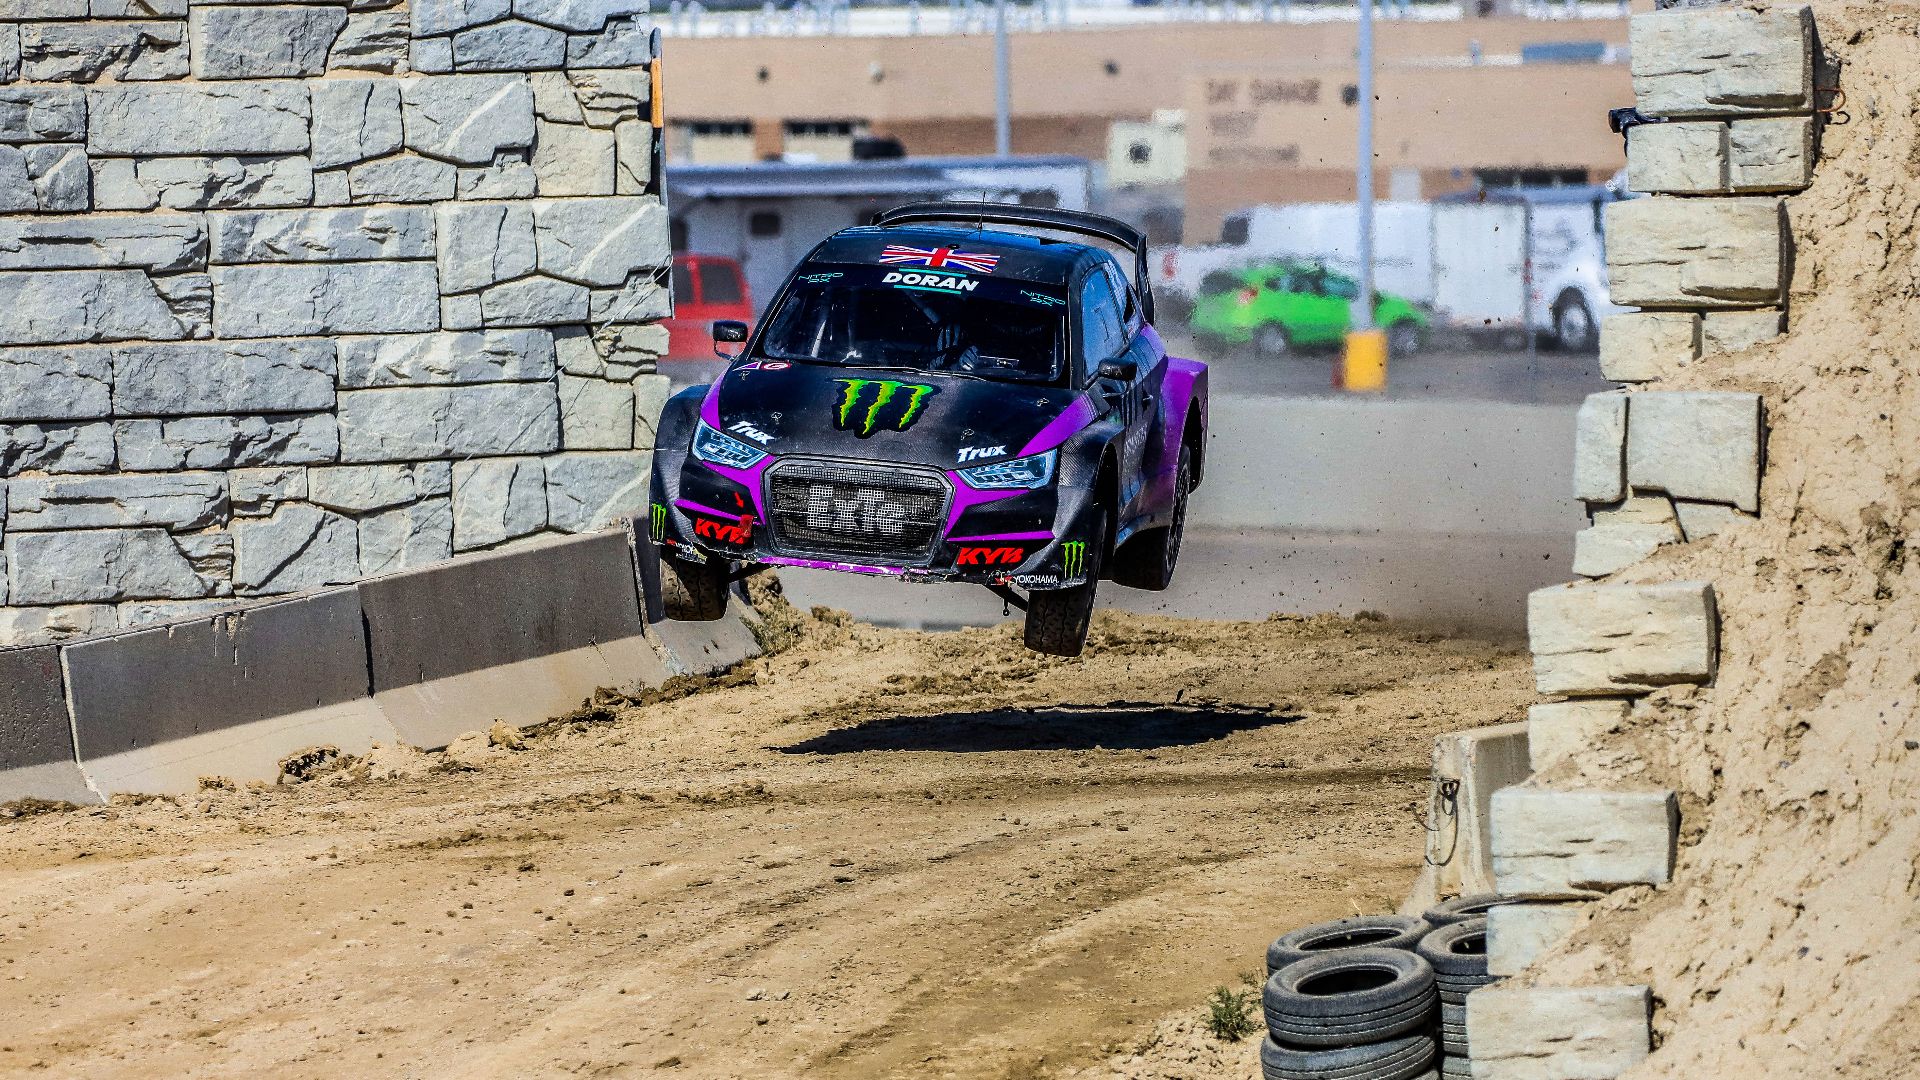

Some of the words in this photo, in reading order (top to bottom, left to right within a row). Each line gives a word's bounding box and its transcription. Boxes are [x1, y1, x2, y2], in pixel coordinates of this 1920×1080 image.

[797, 272, 844, 281] NITRO
[882, 272, 979, 292] DORAN
[1020, 290, 1066, 305] NITRO
[727, 421, 775, 445] Trux
[957, 445, 1007, 463] Trux
[957, 547, 1024, 565] KYB
[1013, 574, 1059, 584] YOKOHAMA
